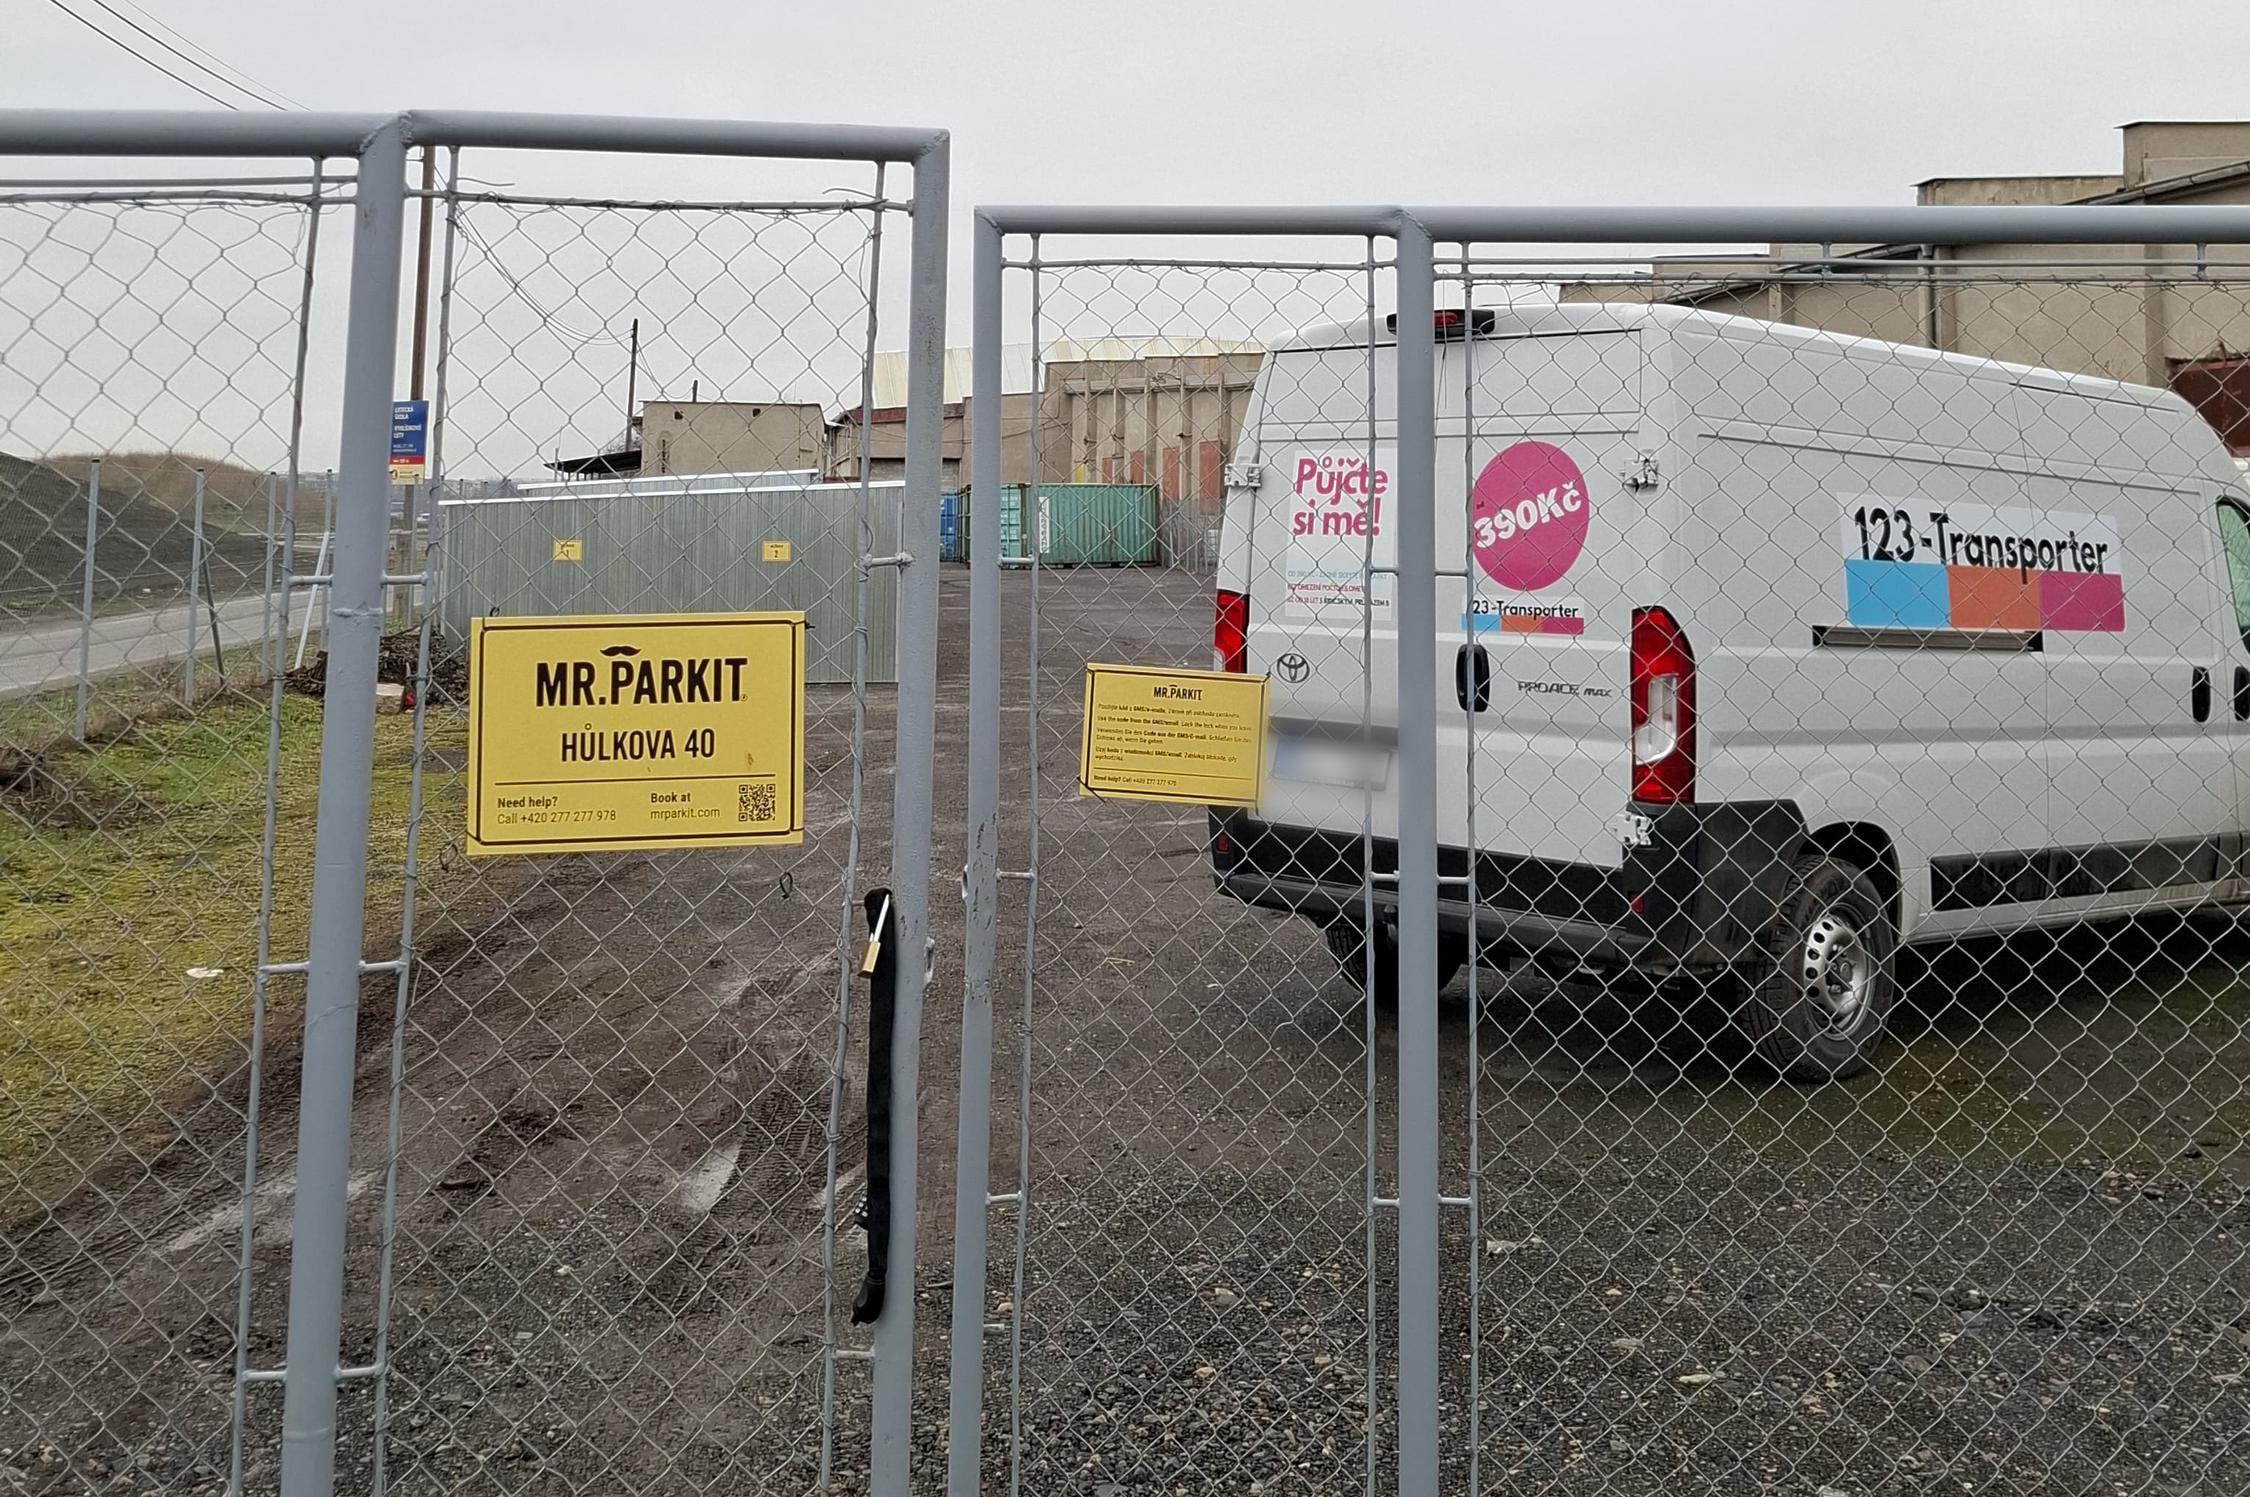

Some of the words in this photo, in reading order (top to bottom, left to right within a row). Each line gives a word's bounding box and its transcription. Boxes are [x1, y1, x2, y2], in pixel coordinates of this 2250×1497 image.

[1296, 456, 1388, 505] Půjčte
[1293, 498, 1315, 535] si
[1322, 497, 1381, 536] mě!
[1474, 481, 1582, 548] 390Kč
[1855, 506, 2108, 585] 123-Transporter
[1471, 601, 1579, 620] 23-Transporter
[536, 657, 748, 708] MR.PARKIT
[1518, 681, 1579, 696] PROACE
[1153, 686, 1202, 701] MR.PARKIT
[561, 723, 676, 762] HŮLKOVA
[684, 728, 716, 758] 40
[497, 798, 526, 809] Need
[528, 796, 558, 811] help?
[650, 792, 678, 804] Book
[680, 792, 692, 803] at
[497, 813, 518, 825] Call
[520, 812, 548, 824] +420
[550, 812, 571, 823] 277
[573, 811, 594, 822] 277
[596, 810, 617, 821] 978
[650, 807, 721, 821] mrparkit.com
